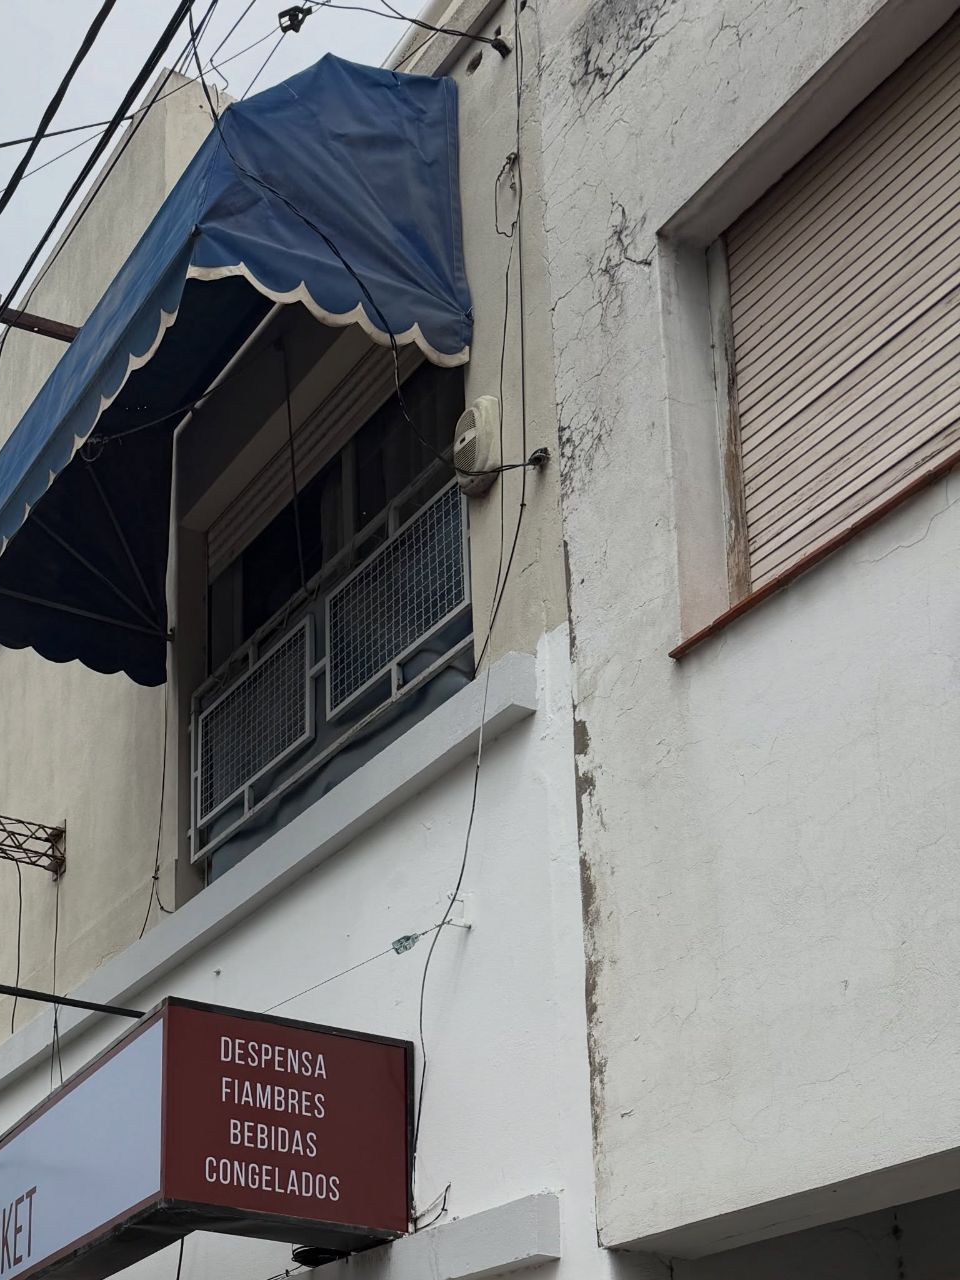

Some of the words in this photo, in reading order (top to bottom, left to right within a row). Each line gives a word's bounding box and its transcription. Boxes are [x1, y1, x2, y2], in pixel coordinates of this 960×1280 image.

[220, 1036, 327, 1079] DESPENSA
[221, 1077, 325, 1119] FIAMBRES
[230, 1119, 317, 1158] BEBIDAS
[205, 1156, 340, 1201] CONGELADOS
